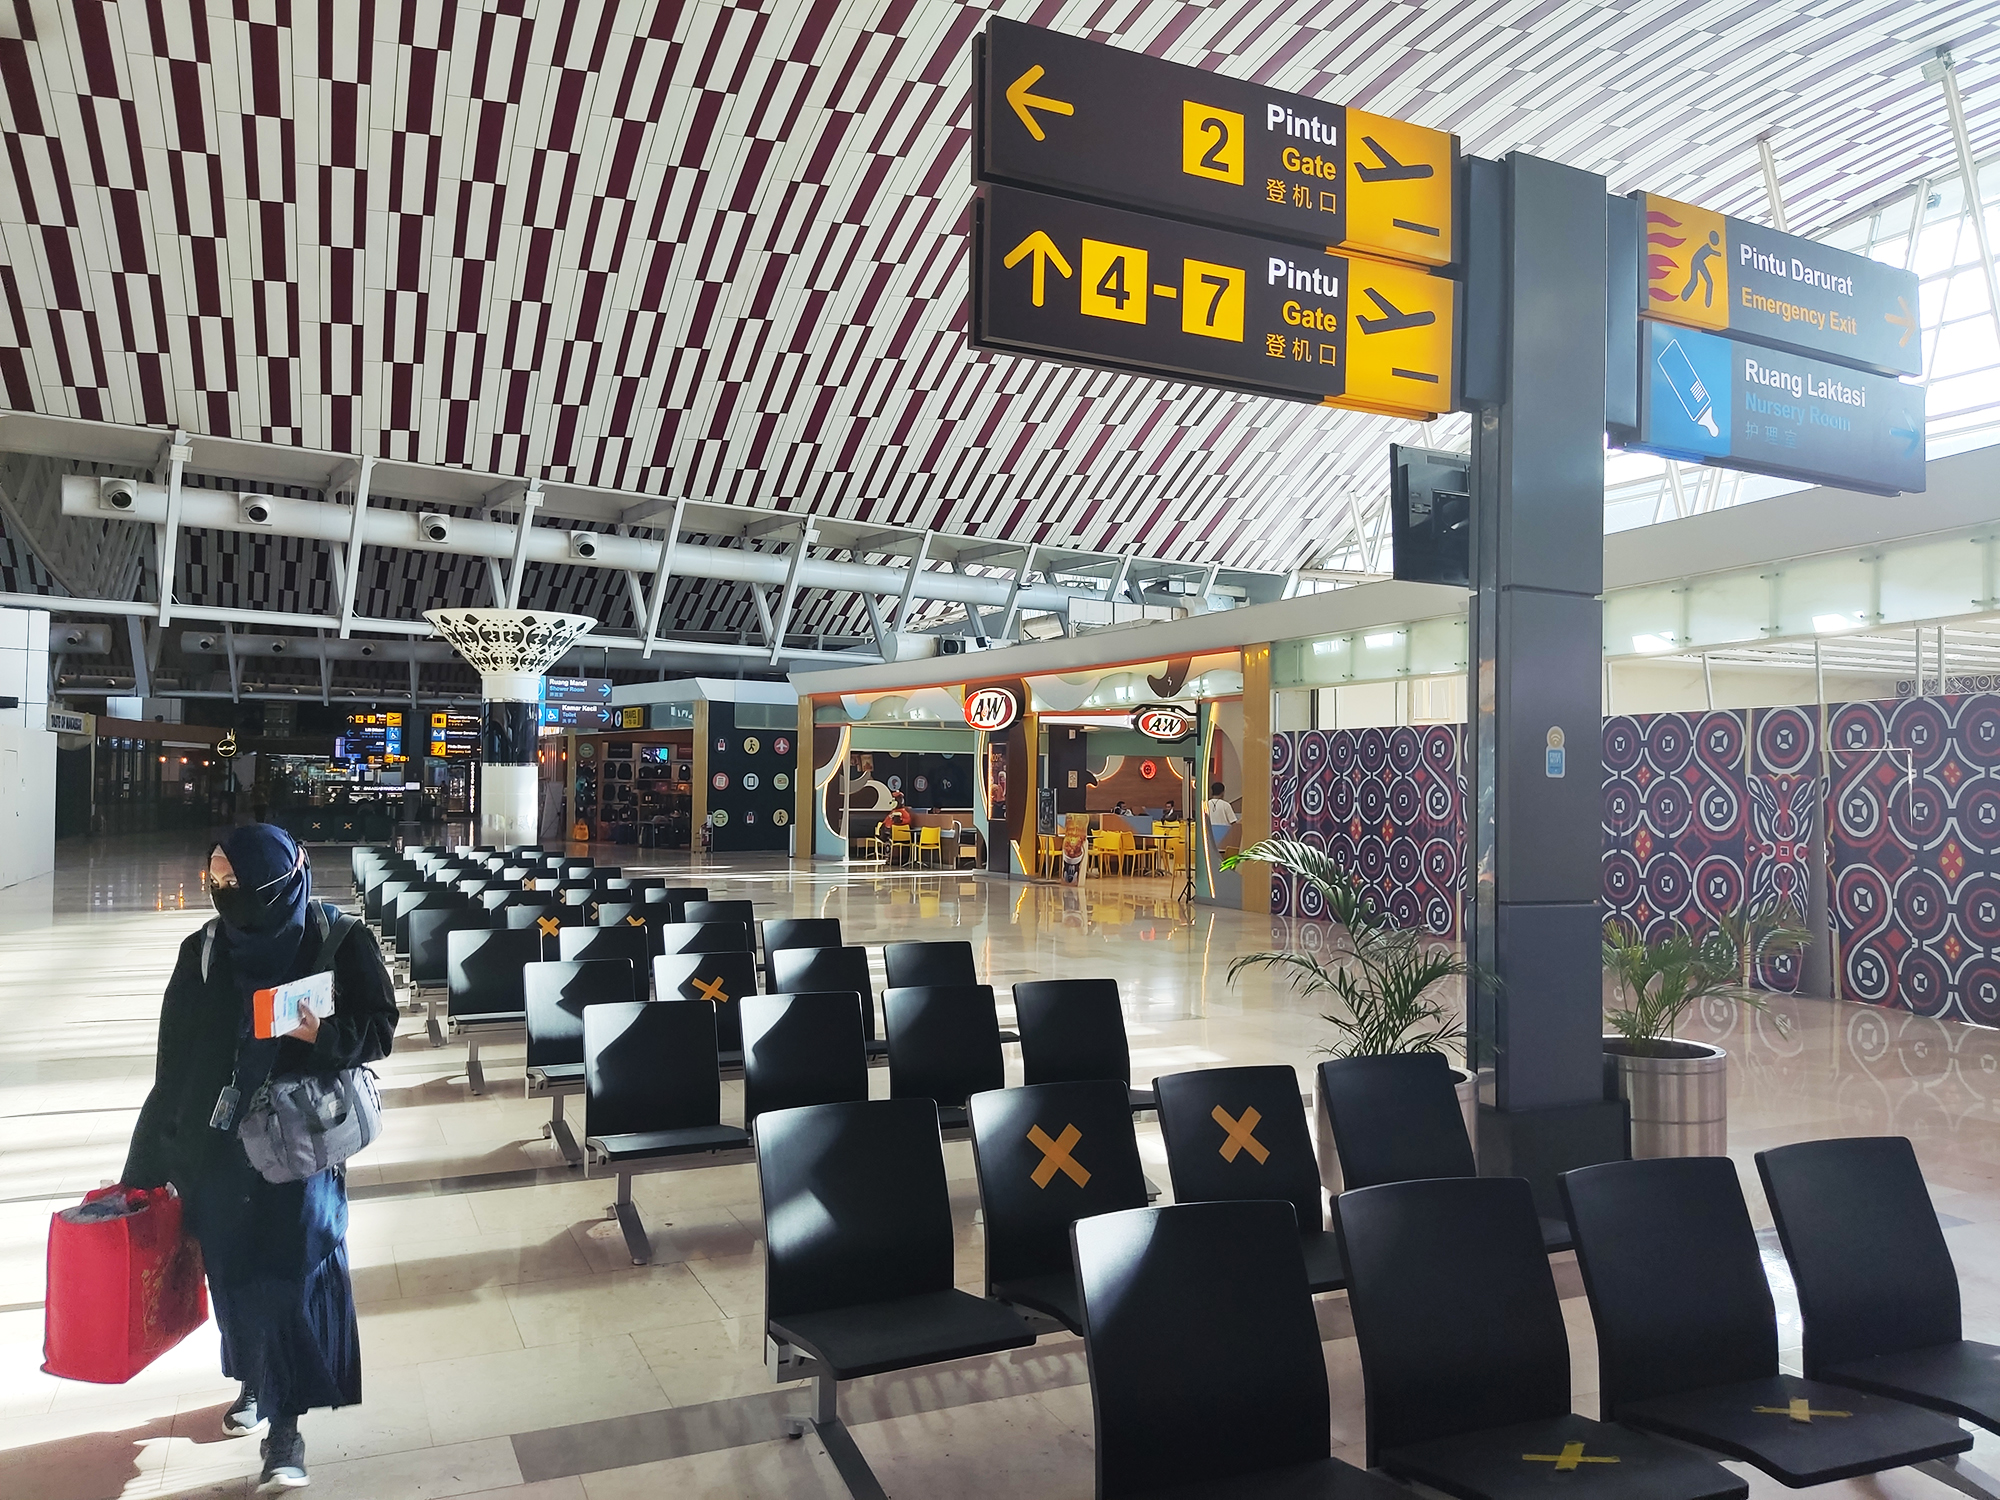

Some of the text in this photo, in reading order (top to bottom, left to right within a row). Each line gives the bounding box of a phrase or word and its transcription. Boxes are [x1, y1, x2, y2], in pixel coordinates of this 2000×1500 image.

[1267, 103, 1337, 147] Pintu
[1200, 117, 1229, 173] 2
[1282, 146, 1337, 180] Gate
[1266, 178, 1337, 214] 登机口
[1268, 257, 1338, 298] Pintu
[1740, 243, 1854, 297] Pintu Darurat
[1282, 300, 1337, 333] Gate
[1741, 286, 1857, 335] Emergency Exit
[1265, 333, 1336, 367] 登机口
[1745, 358, 1866, 408] Ruang Laktasi
[1745, 391, 1851, 432] Nursery Room
[1745, 420, 1797, 449] 护理室
[549, 679, 588, 687] Ruang Mandi
[624, 710, 637, 719] TRAVEL
[972, 696, 1005, 722] A&W
[1149, 717, 1180, 732] A&W
